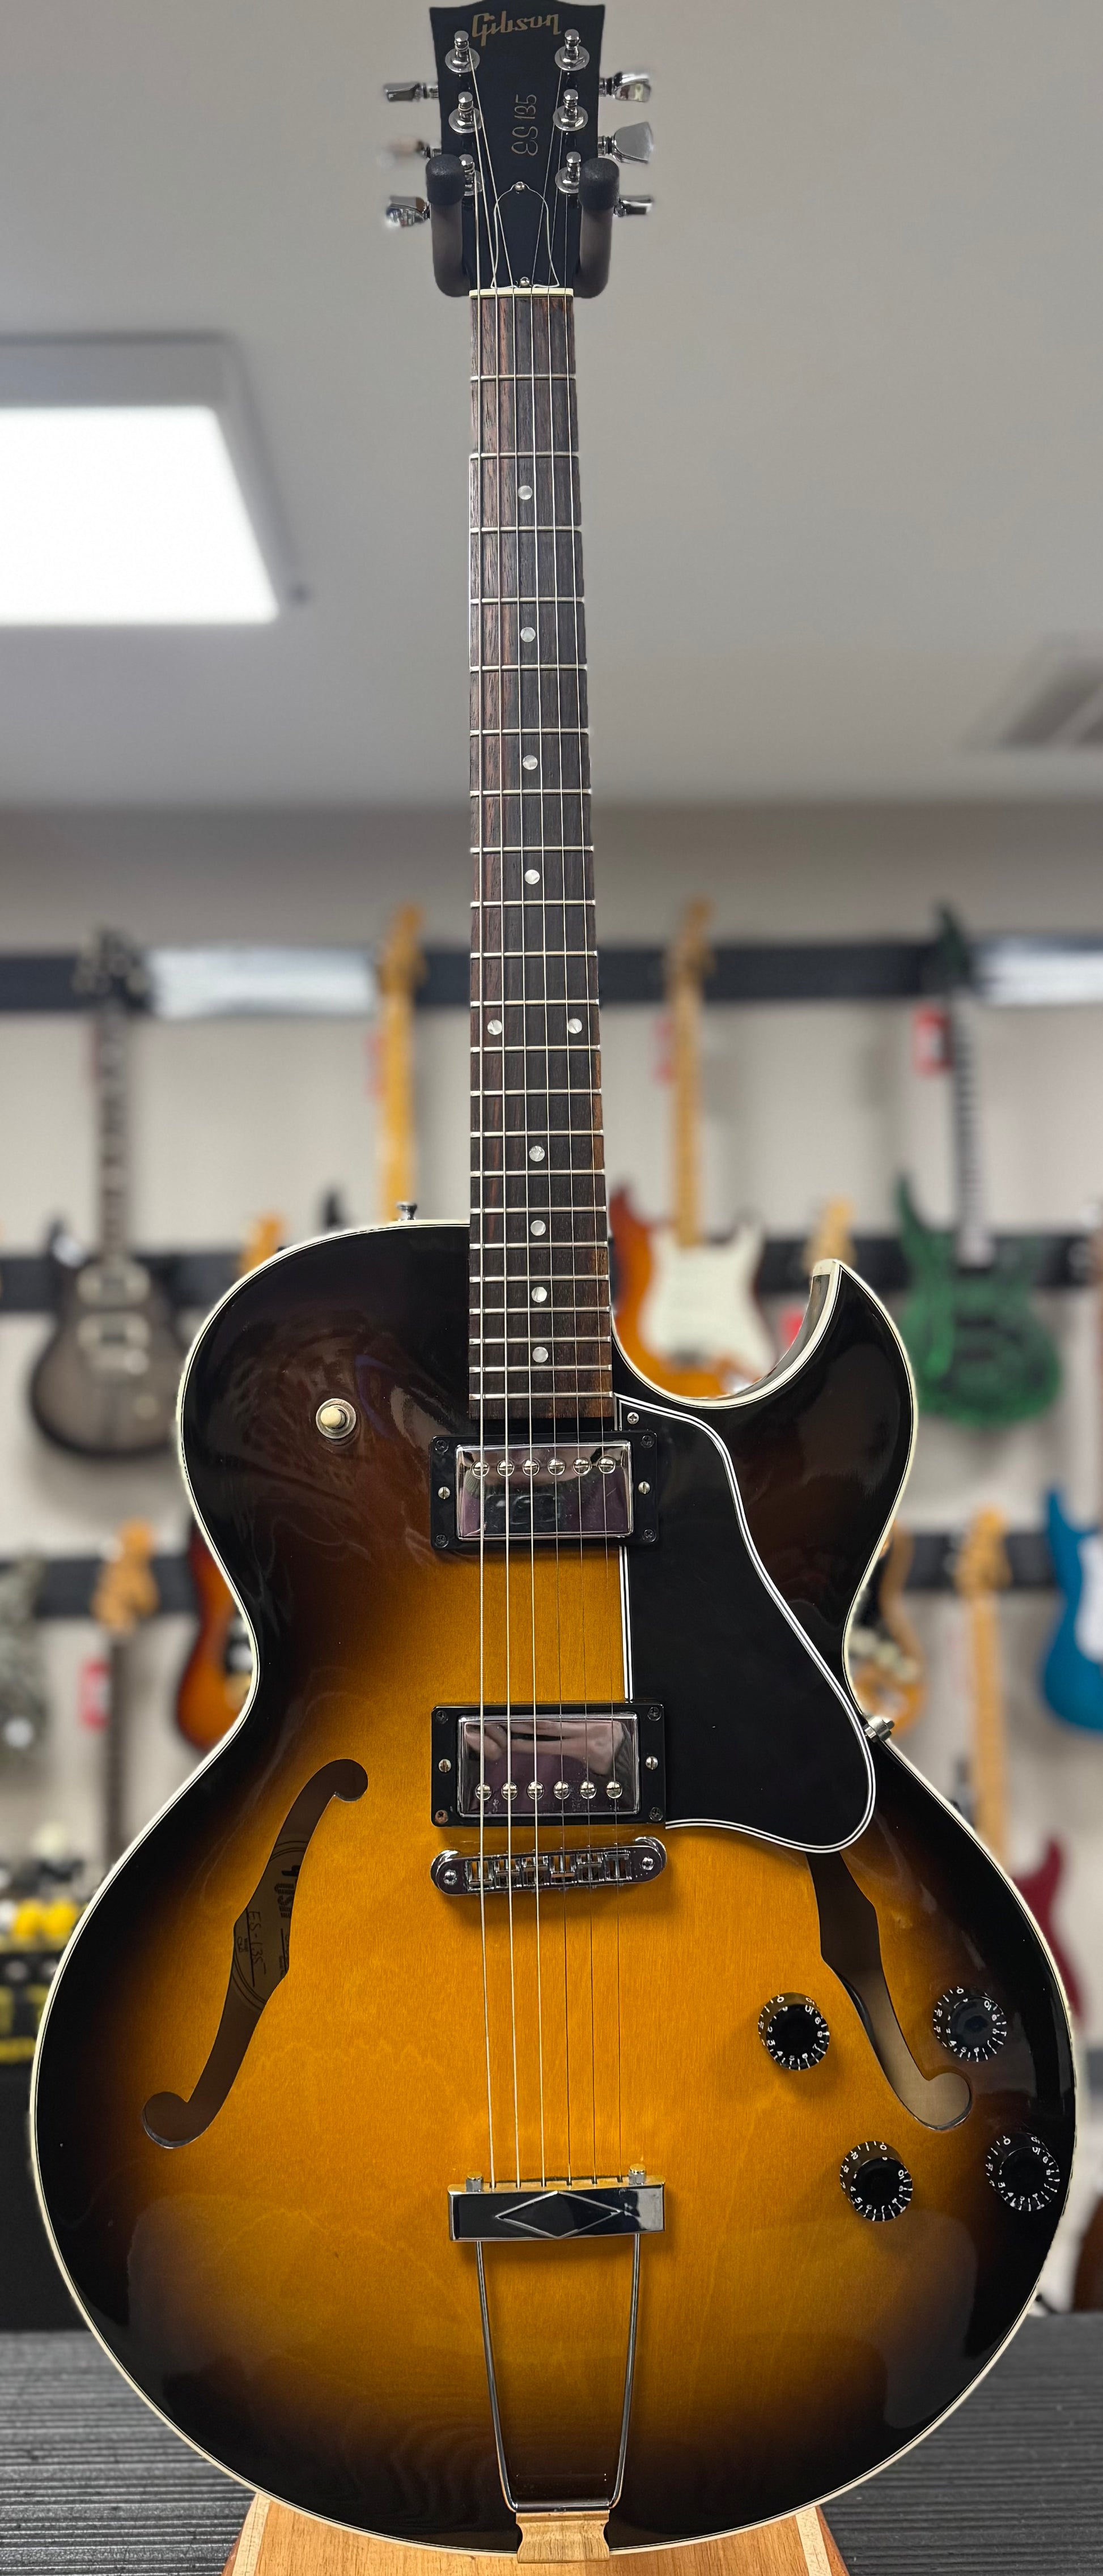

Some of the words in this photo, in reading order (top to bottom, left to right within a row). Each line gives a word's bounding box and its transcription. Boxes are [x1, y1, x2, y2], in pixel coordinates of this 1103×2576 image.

[472, 11, 561, 46] Gibson
[514, 94, 537, 120] 135
[248, 1911, 266, 1975] ES-135
